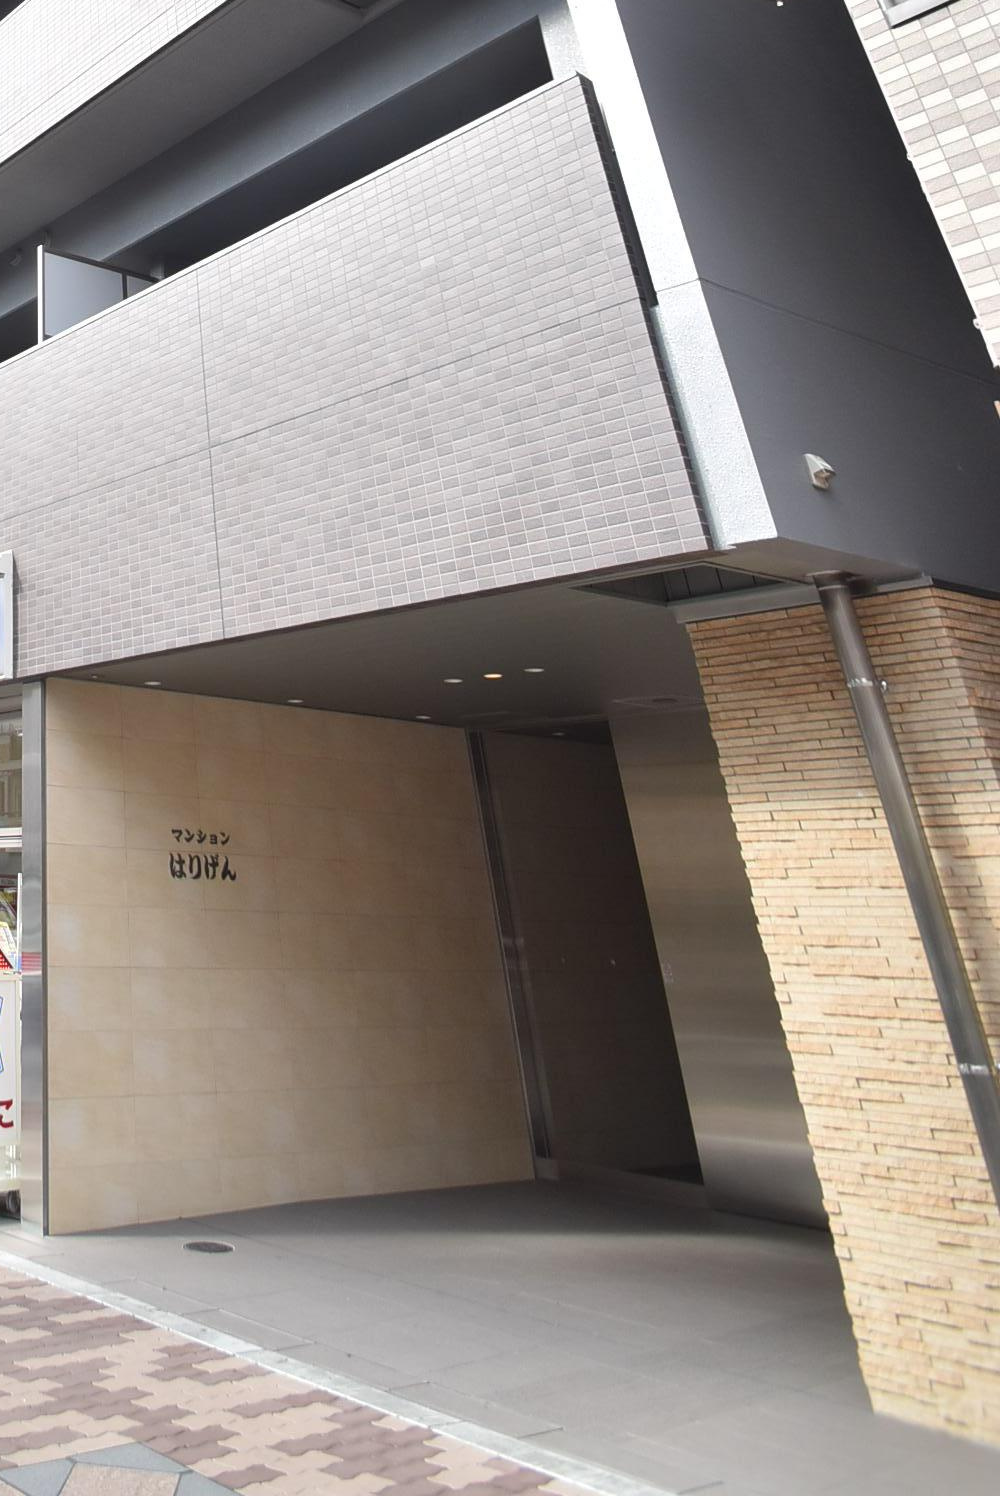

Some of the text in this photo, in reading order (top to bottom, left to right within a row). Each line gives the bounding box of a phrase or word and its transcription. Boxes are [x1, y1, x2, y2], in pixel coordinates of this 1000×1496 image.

[171, 828, 230, 845] マンション
[169, 852, 237, 881] はりげん
